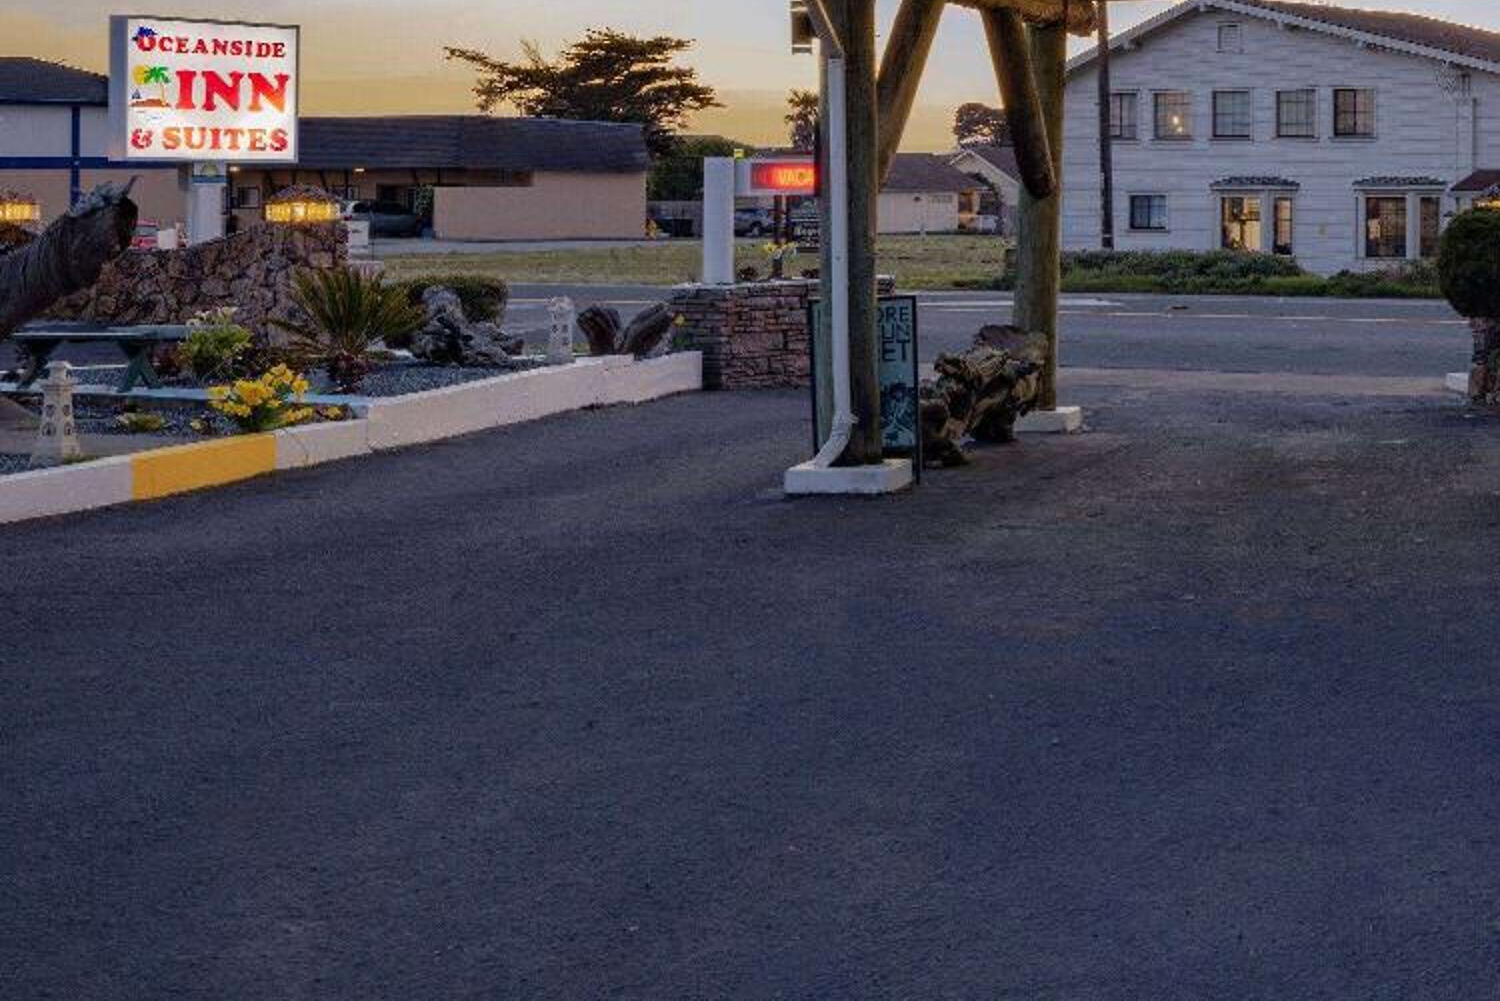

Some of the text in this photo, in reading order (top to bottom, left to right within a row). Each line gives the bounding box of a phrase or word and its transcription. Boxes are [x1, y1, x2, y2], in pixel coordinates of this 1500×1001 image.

[135, 34, 286, 59] OCEANSIDE
[175, 69, 290, 114] INN
[130, 126, 289, 152] & SUITES
